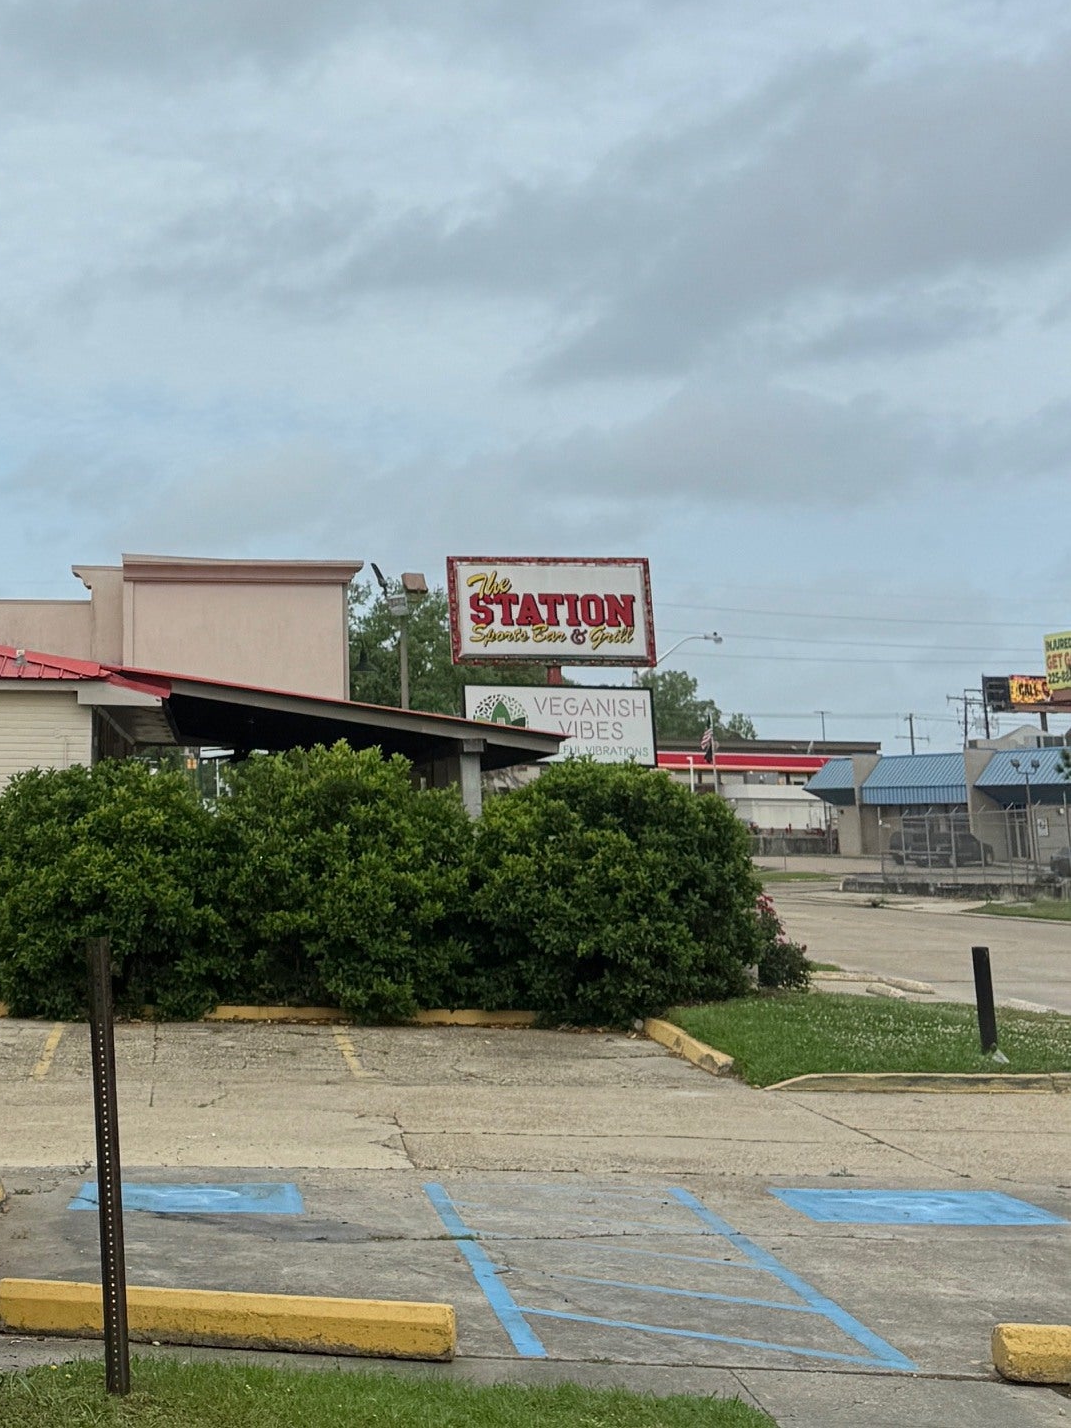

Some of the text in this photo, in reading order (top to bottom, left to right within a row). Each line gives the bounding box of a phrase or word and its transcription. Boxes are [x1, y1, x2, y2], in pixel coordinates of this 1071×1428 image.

[466, 570, 512, 599] The
[469, 592, 636, 628] STATION
[470, 623, 635, 650] Sports Bar & Grill
[534, 697, 647, 718] VEGANISH
[558, 720, 624, 740] VIBES
[586, 745, 649, 757] VIBRATIONS
